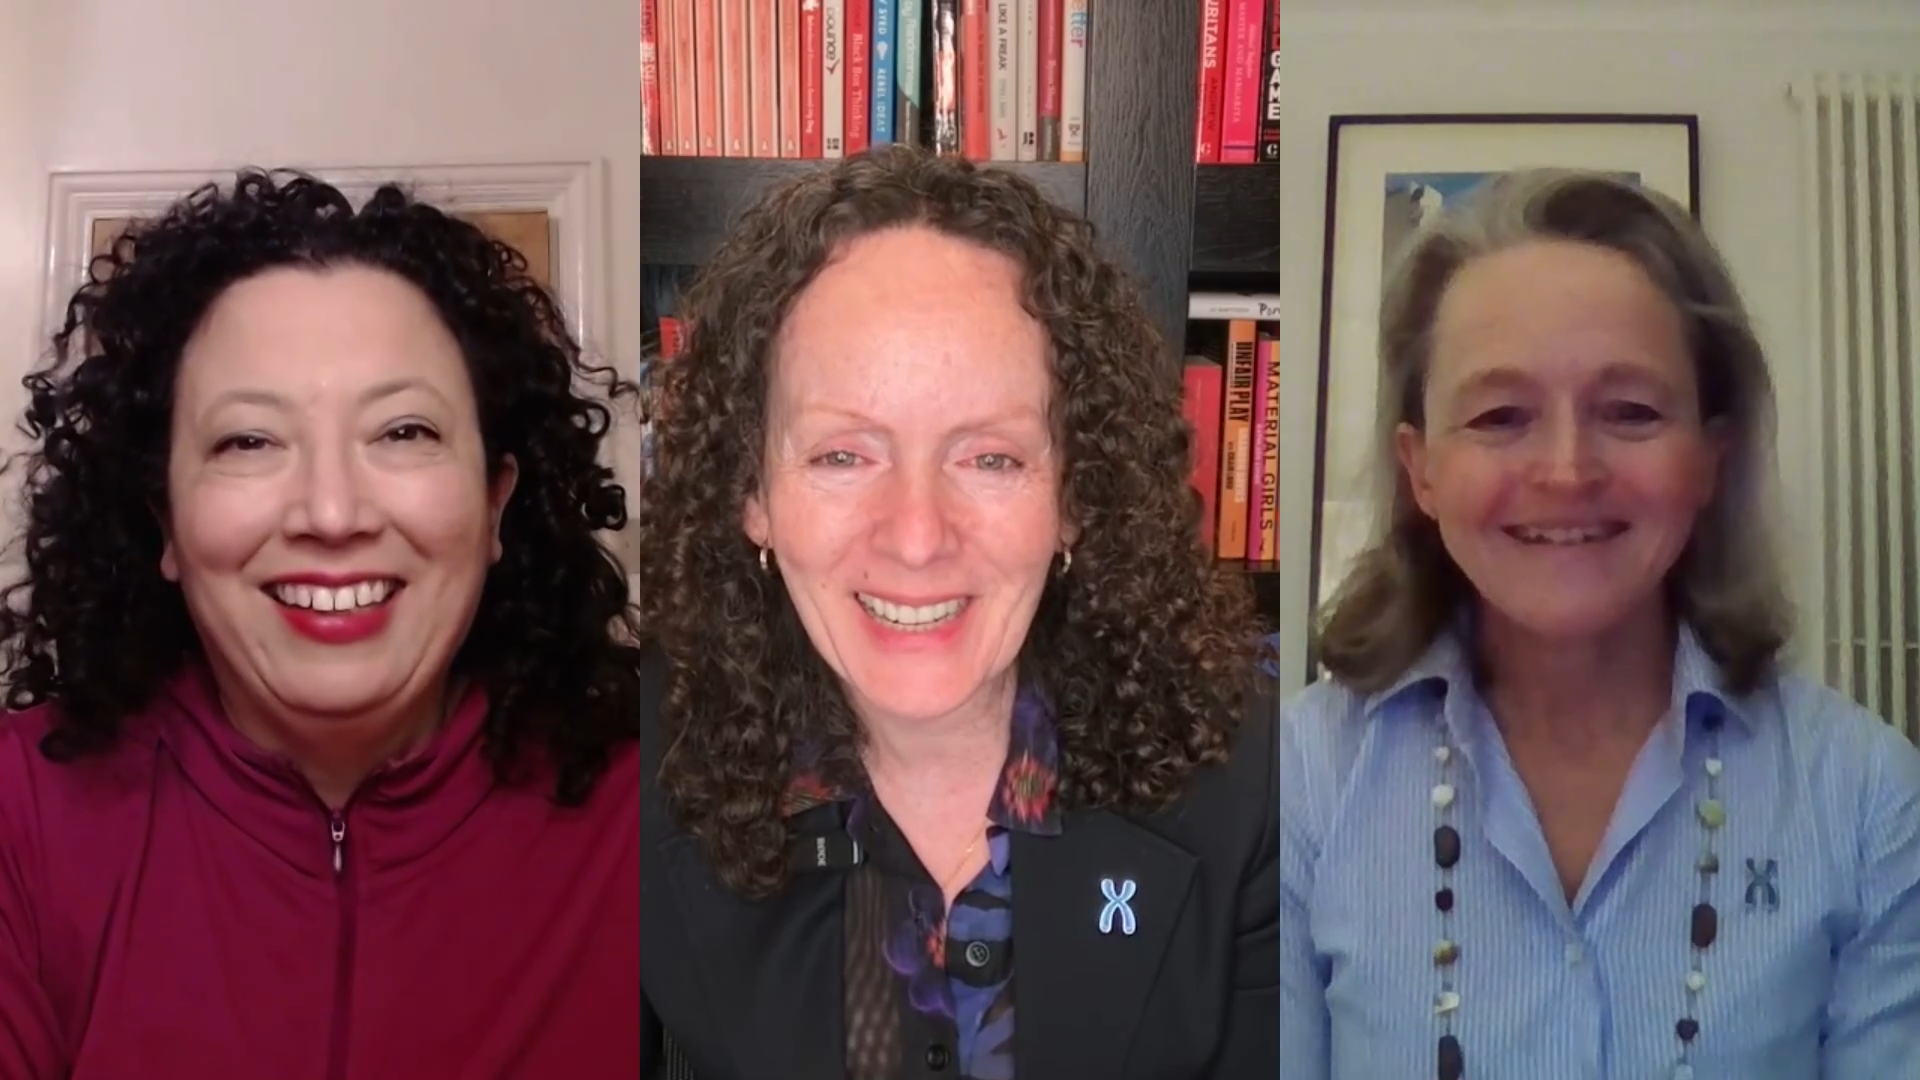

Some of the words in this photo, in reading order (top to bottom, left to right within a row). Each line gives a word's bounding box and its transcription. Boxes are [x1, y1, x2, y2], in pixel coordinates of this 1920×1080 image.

[878, 8, 888, 35] SYED
[998, 3, 1008, 24] LIKE
[1236, 2, 1247, 39] MASTER
[998, 27, 1008, 36] A
[851, 33, 864, 64] Black
[998, 38, 1008, 71] FREAK
[1235, 43, 1245, 64] AND
[851, 67, 862, 87] Box
[876, 68, 887, 98] REBEL
[1232, 67, 1244, 123] MARGARITA
[848, 88, 862, 138] Thinking
[876, 101, 886, 133] IDEAS
[1234, 341, 1253, 389] UNFAIR
[1228, 390, 1251, 422] PLAY
[1263, 361, 1280, 467] MATERIAL
[1260, 473, 1276, 531] GIRLS
